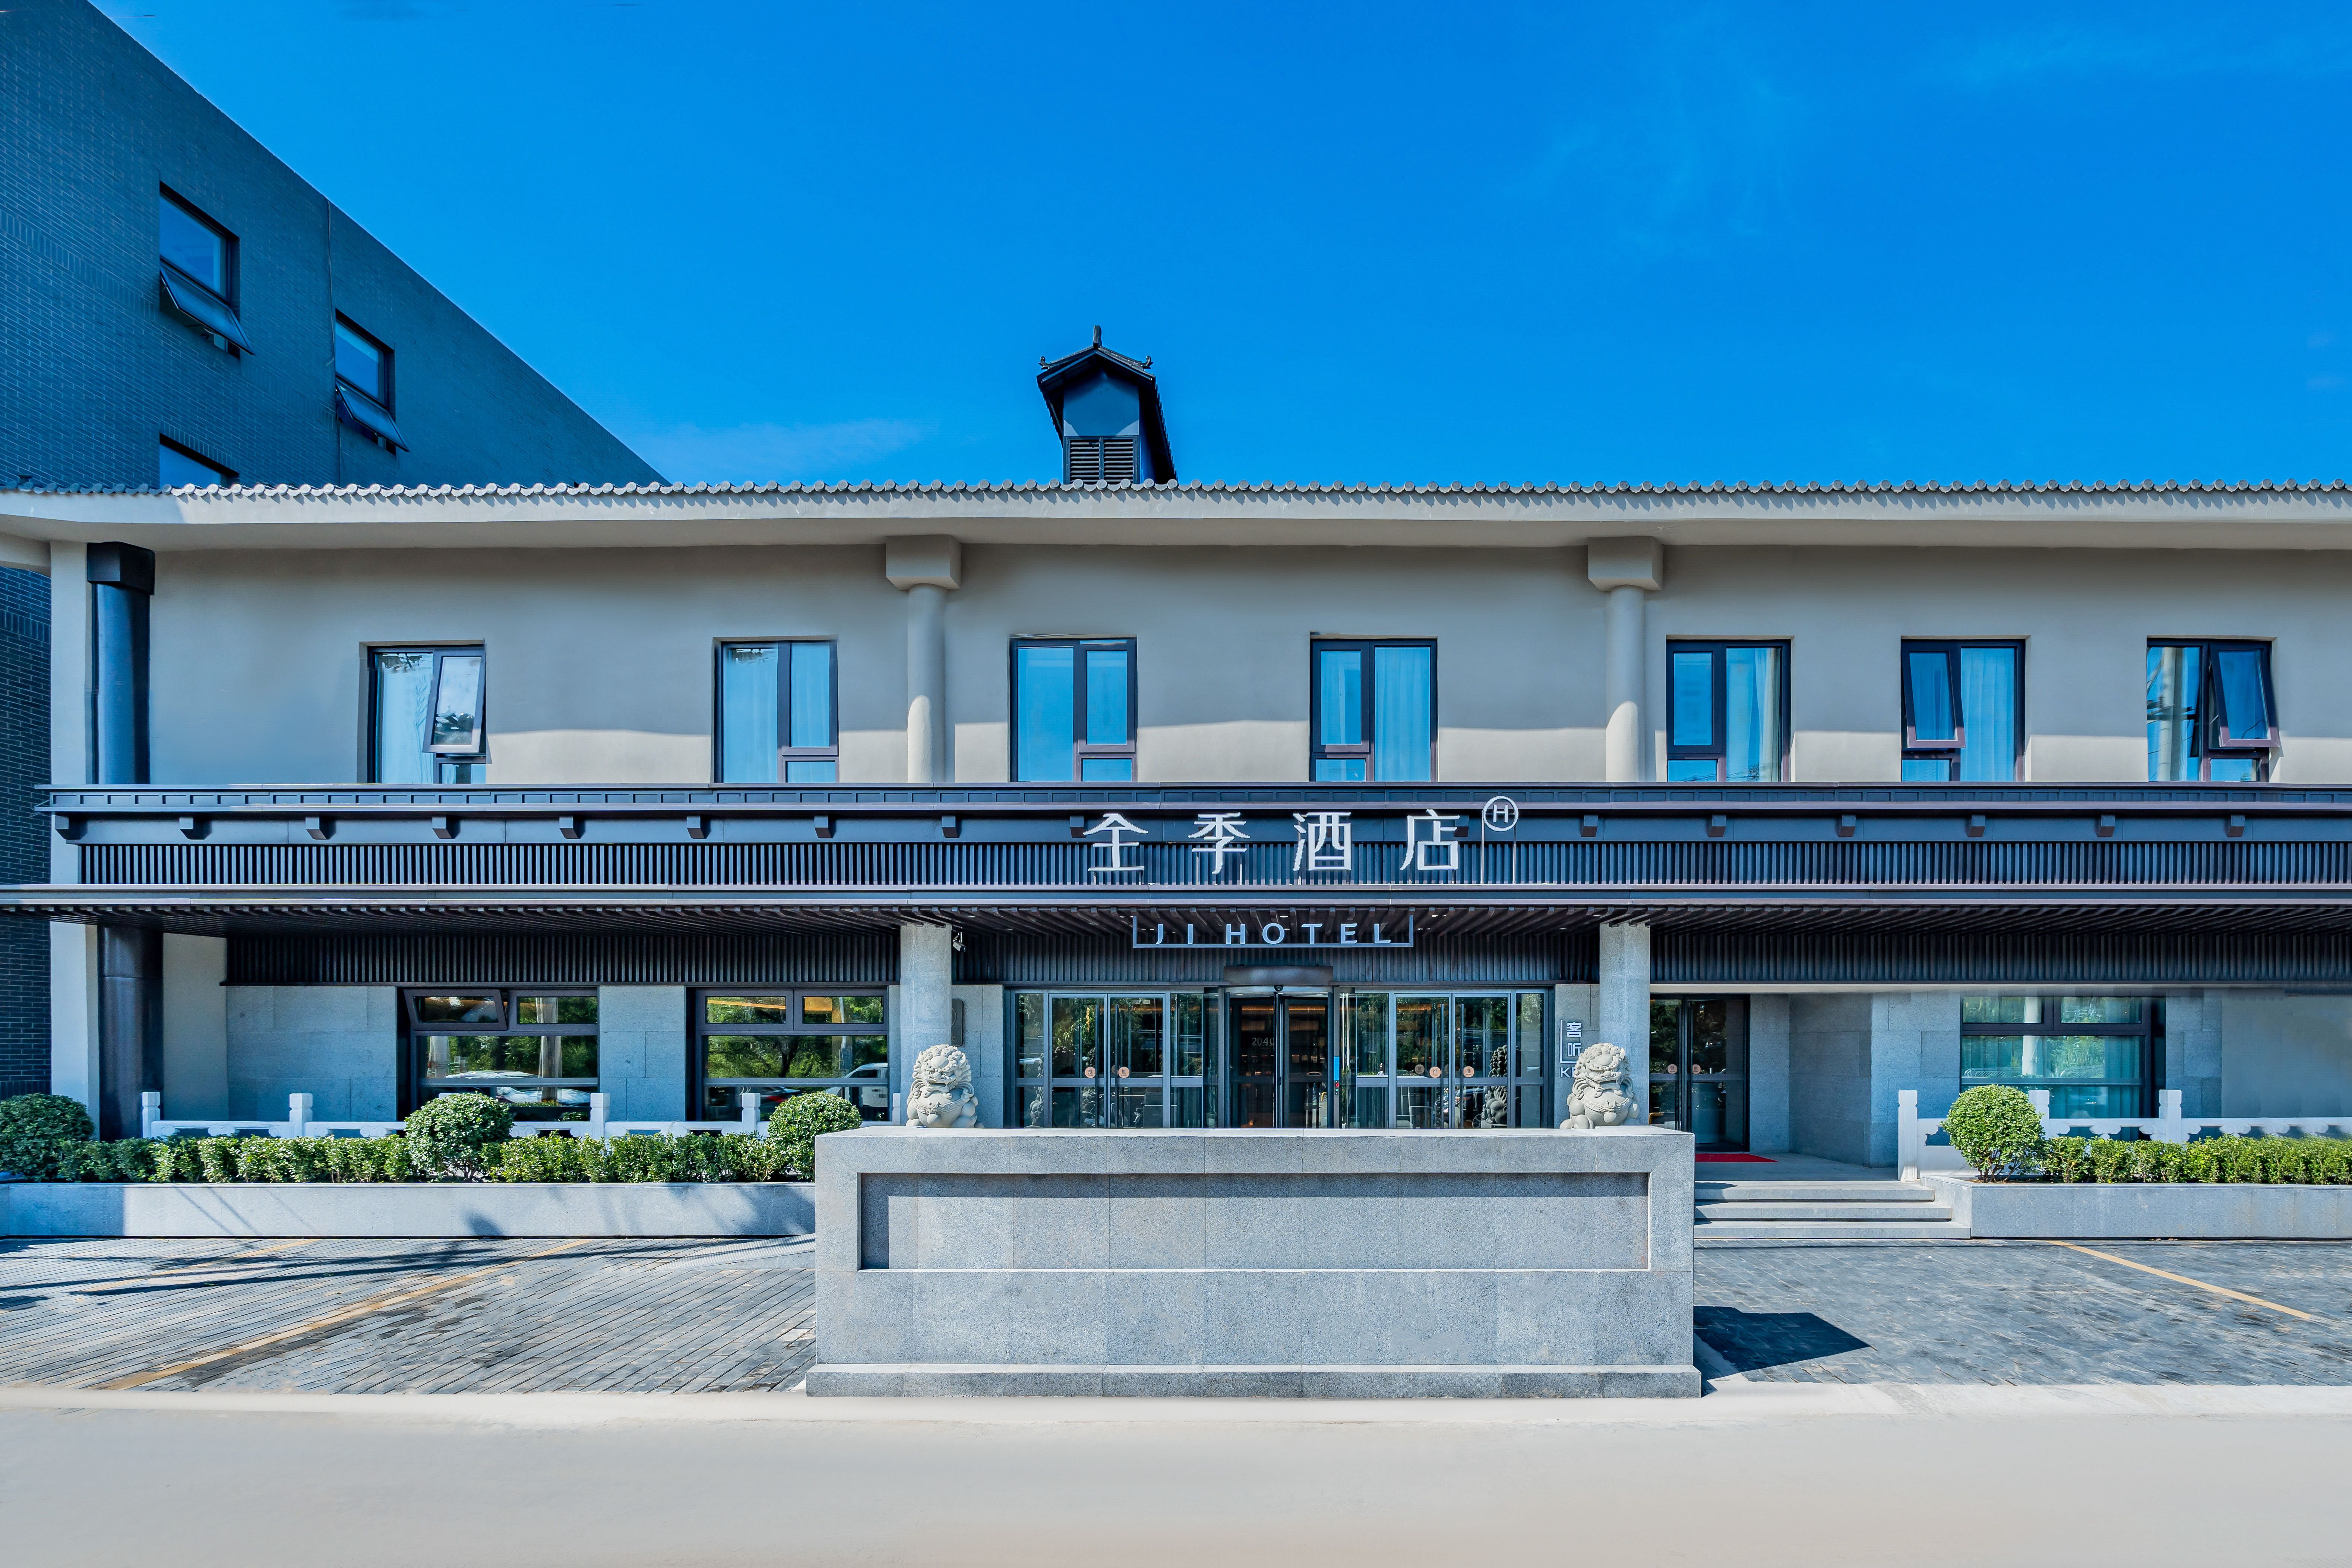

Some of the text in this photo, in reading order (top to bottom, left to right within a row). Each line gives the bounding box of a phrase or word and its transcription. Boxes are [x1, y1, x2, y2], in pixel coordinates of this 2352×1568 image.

[1493, 804, 1508, 823] H
[1083, 809, 1460, 875] 全季酒店
[1156, 923, 1391, 945] JI HOTEL
